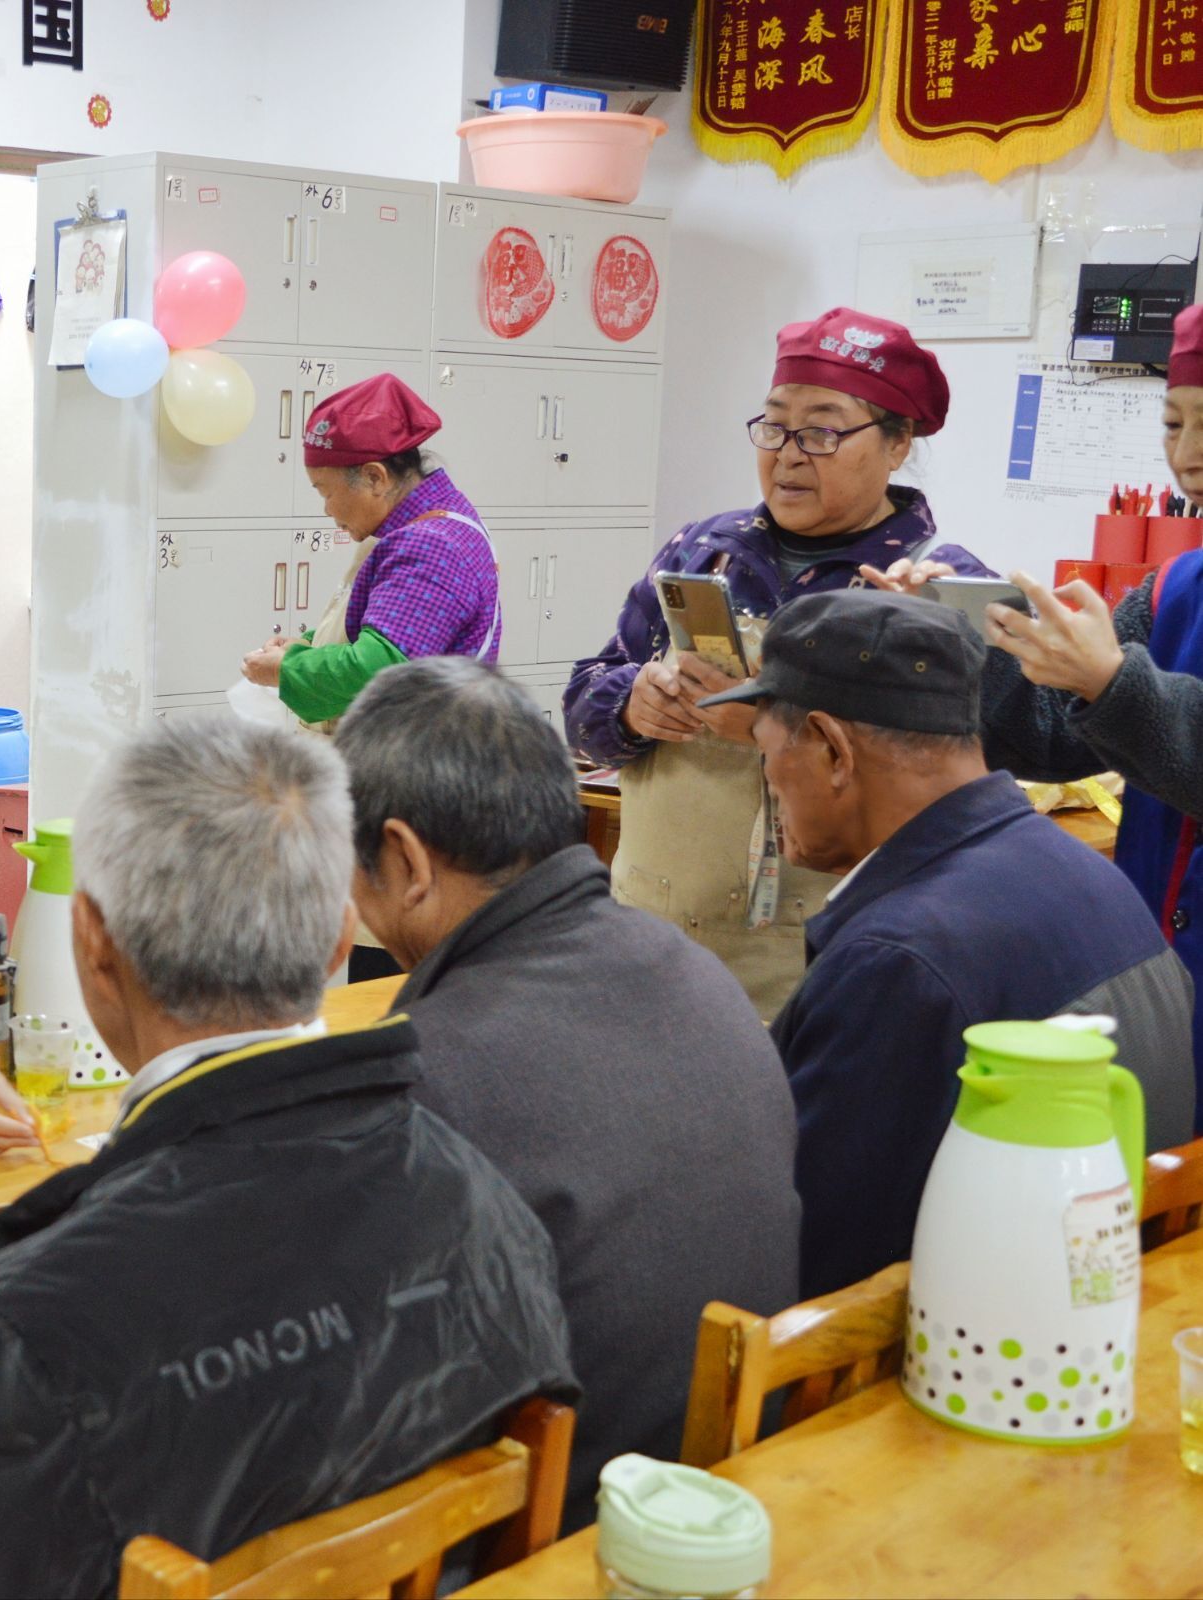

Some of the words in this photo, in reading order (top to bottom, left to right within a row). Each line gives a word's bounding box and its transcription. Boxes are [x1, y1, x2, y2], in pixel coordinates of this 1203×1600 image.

[755, 0, 787, 91] 海深
[798, 9, 836, 86] 春风
[844, 6, 864, 40] 店长
